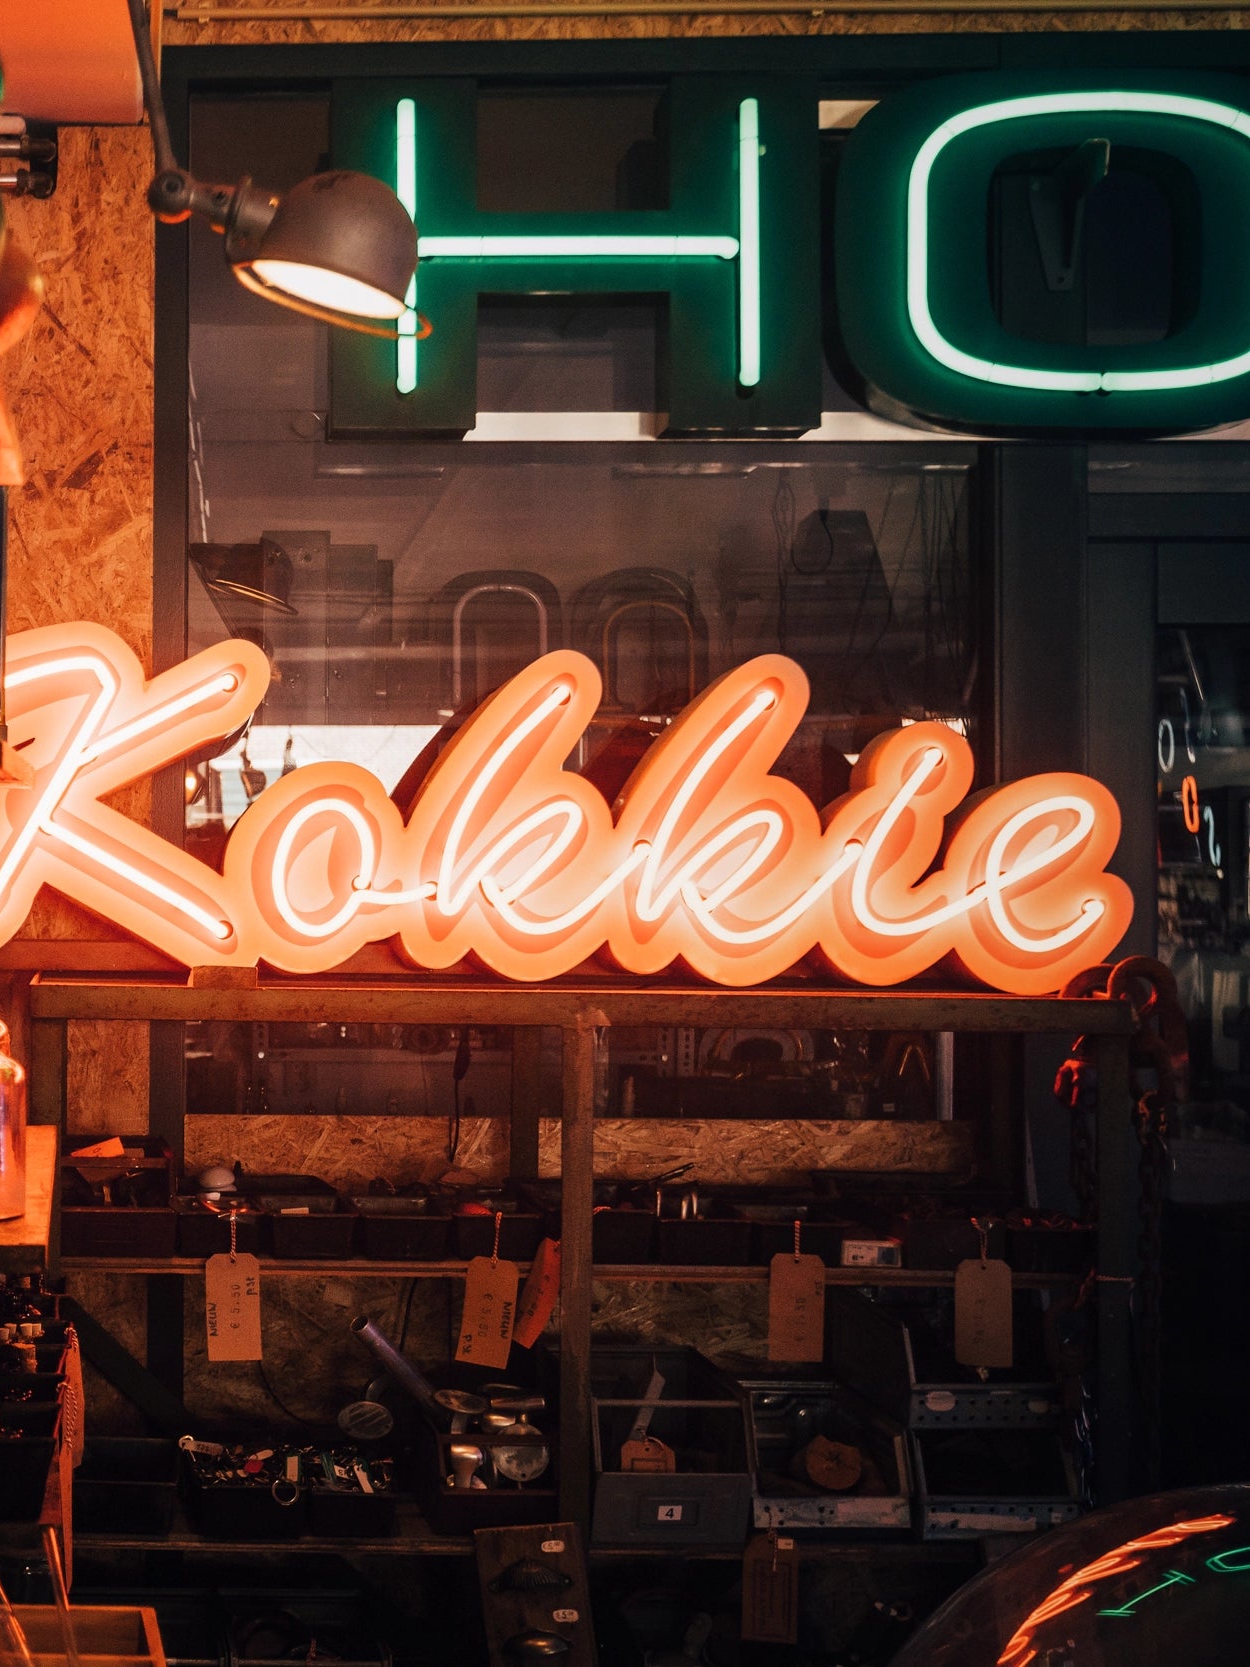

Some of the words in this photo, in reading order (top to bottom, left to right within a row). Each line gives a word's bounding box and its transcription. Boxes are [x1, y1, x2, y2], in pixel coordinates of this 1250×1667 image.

[330, 72, 1250, 438] HO
[208, 1302, 219, 1337] NIEUW
[499, 1301, 513, 1340] NIEUW
[665, 1507, 676, 1519] 4
